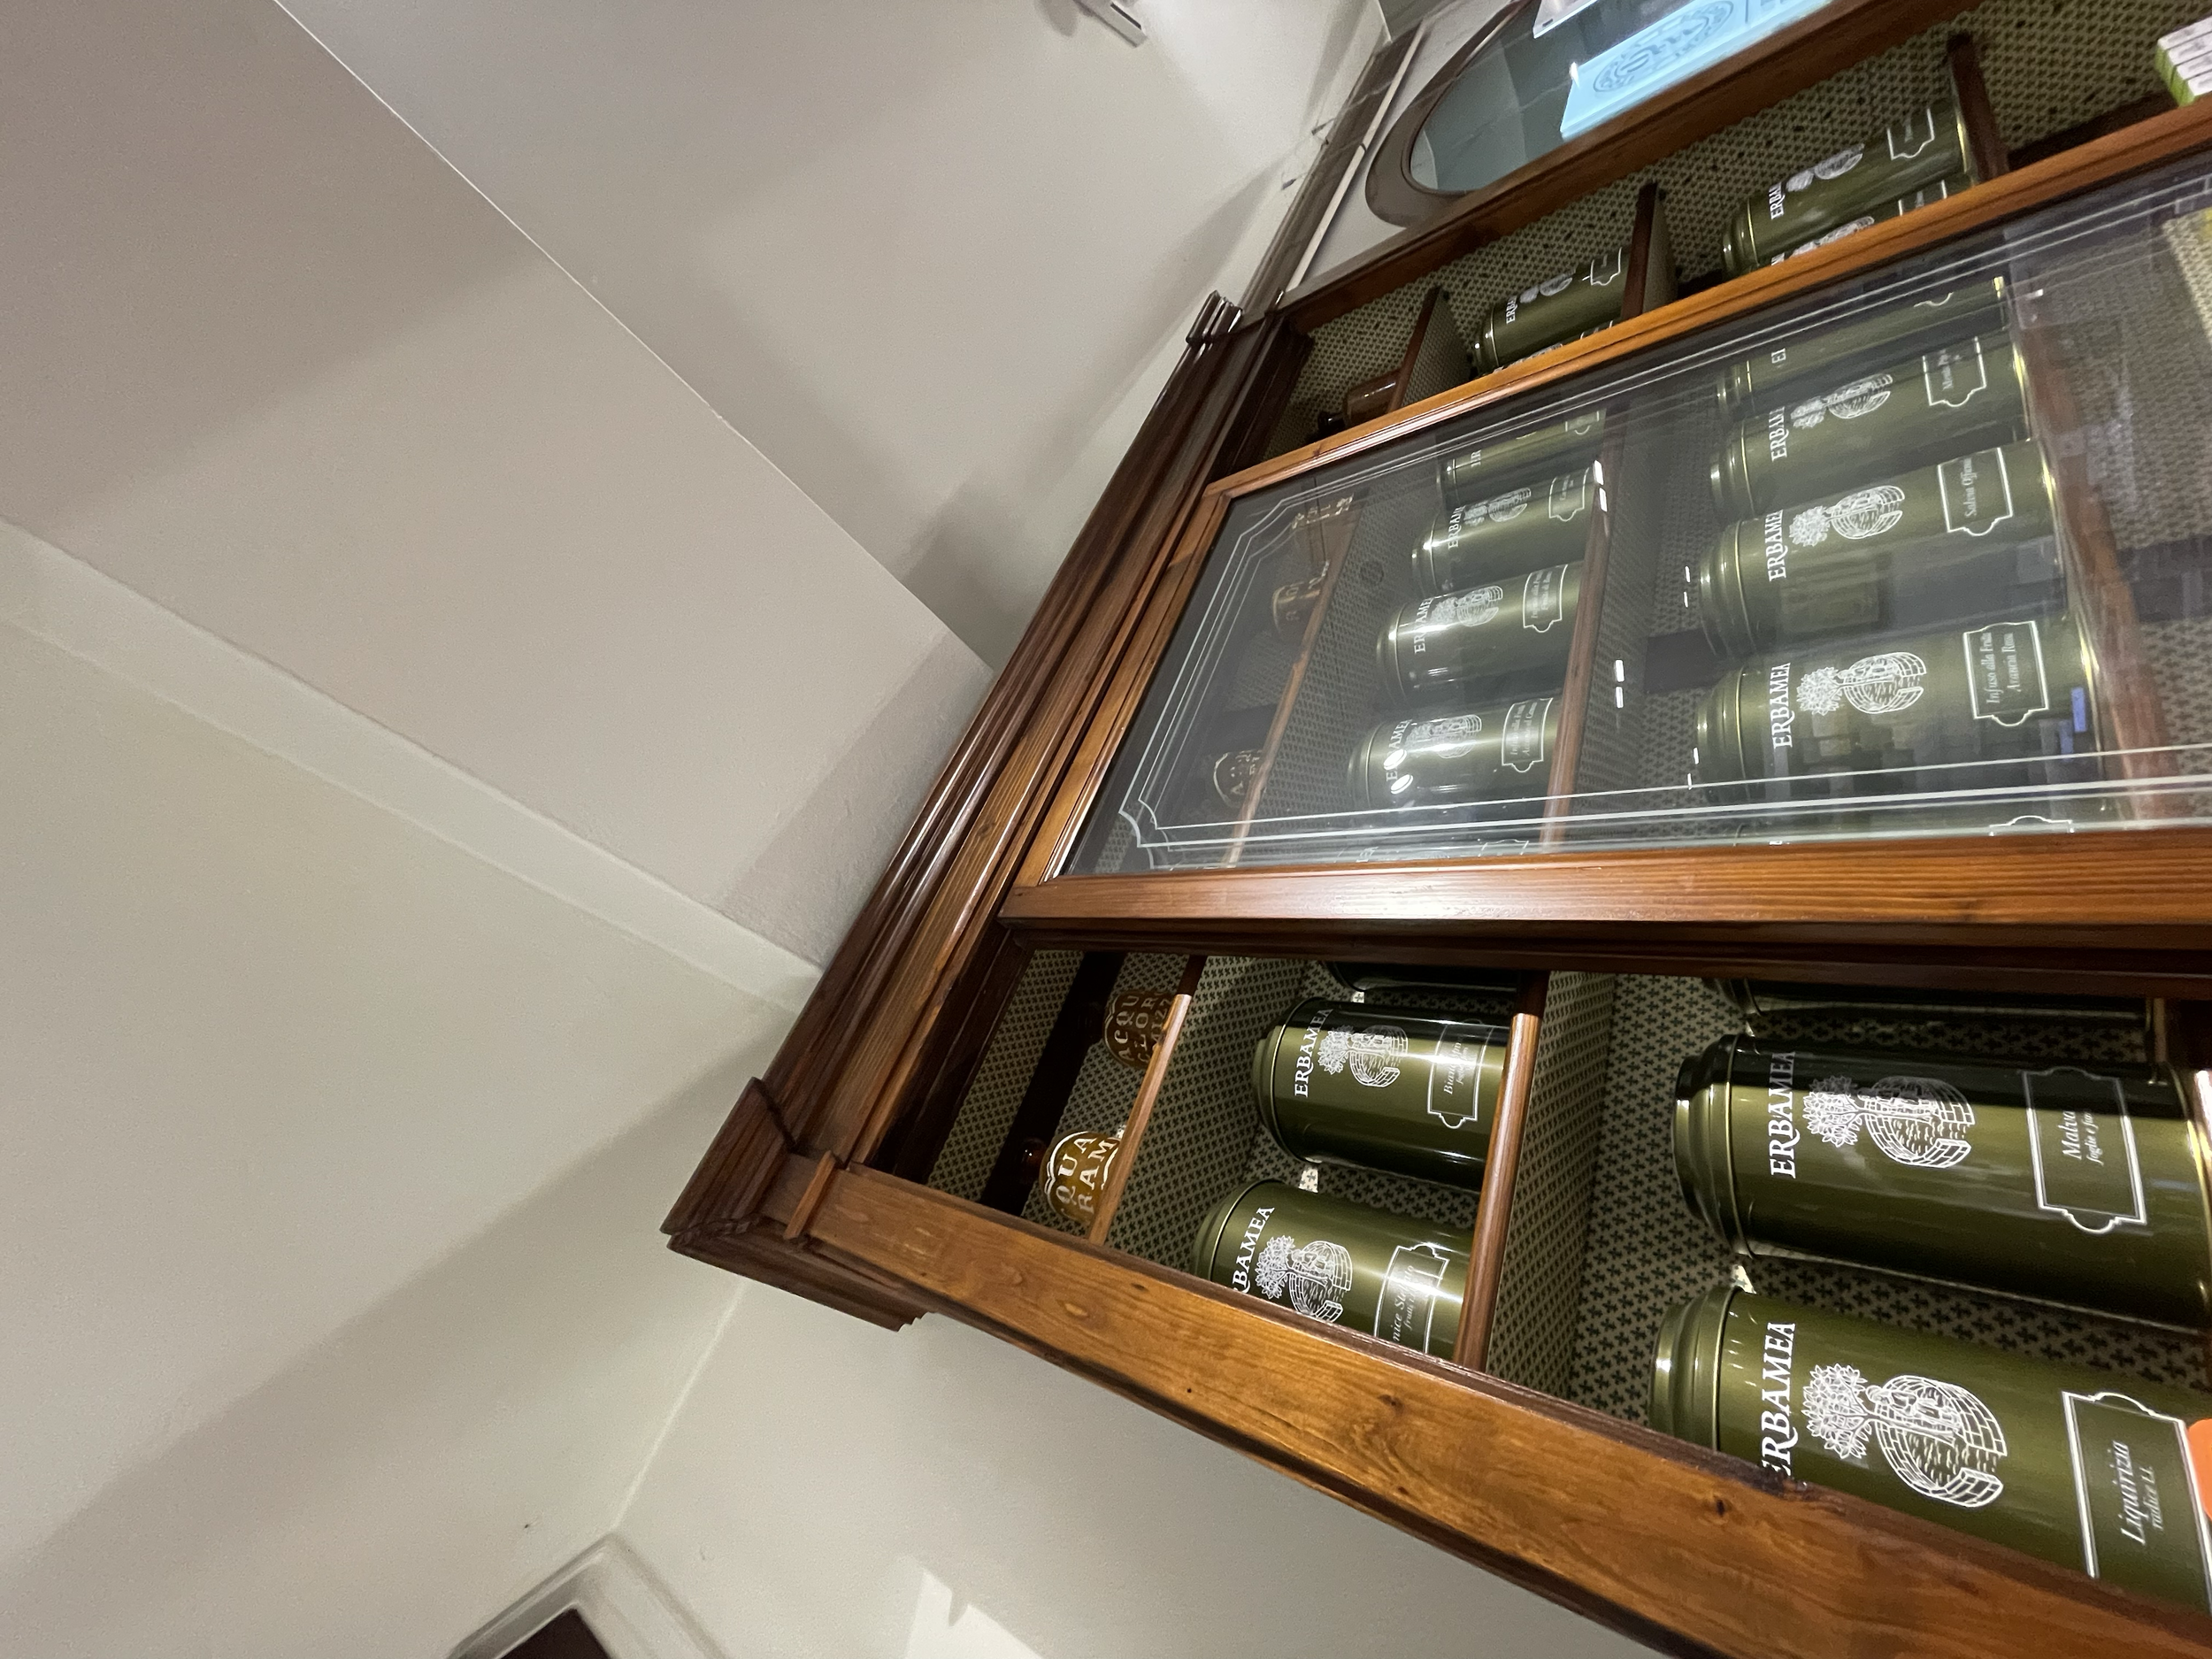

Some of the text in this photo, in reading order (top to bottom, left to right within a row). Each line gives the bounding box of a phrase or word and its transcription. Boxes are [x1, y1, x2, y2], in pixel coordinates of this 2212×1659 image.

[1770, 662, 1796, 749] ERBAMEA
[1294, 1009, 1333, 1097] ERBAMEA
[1768, 1051, 1801, 1179] ERBAMEA
[2056, 1110, 2082, 1161] Malva
[1390, 1312, 1403, 1342] nice
[2107, 1440, 2147, 1547] Liquirizia
[2142, 1484, 2164, 1532] radice
